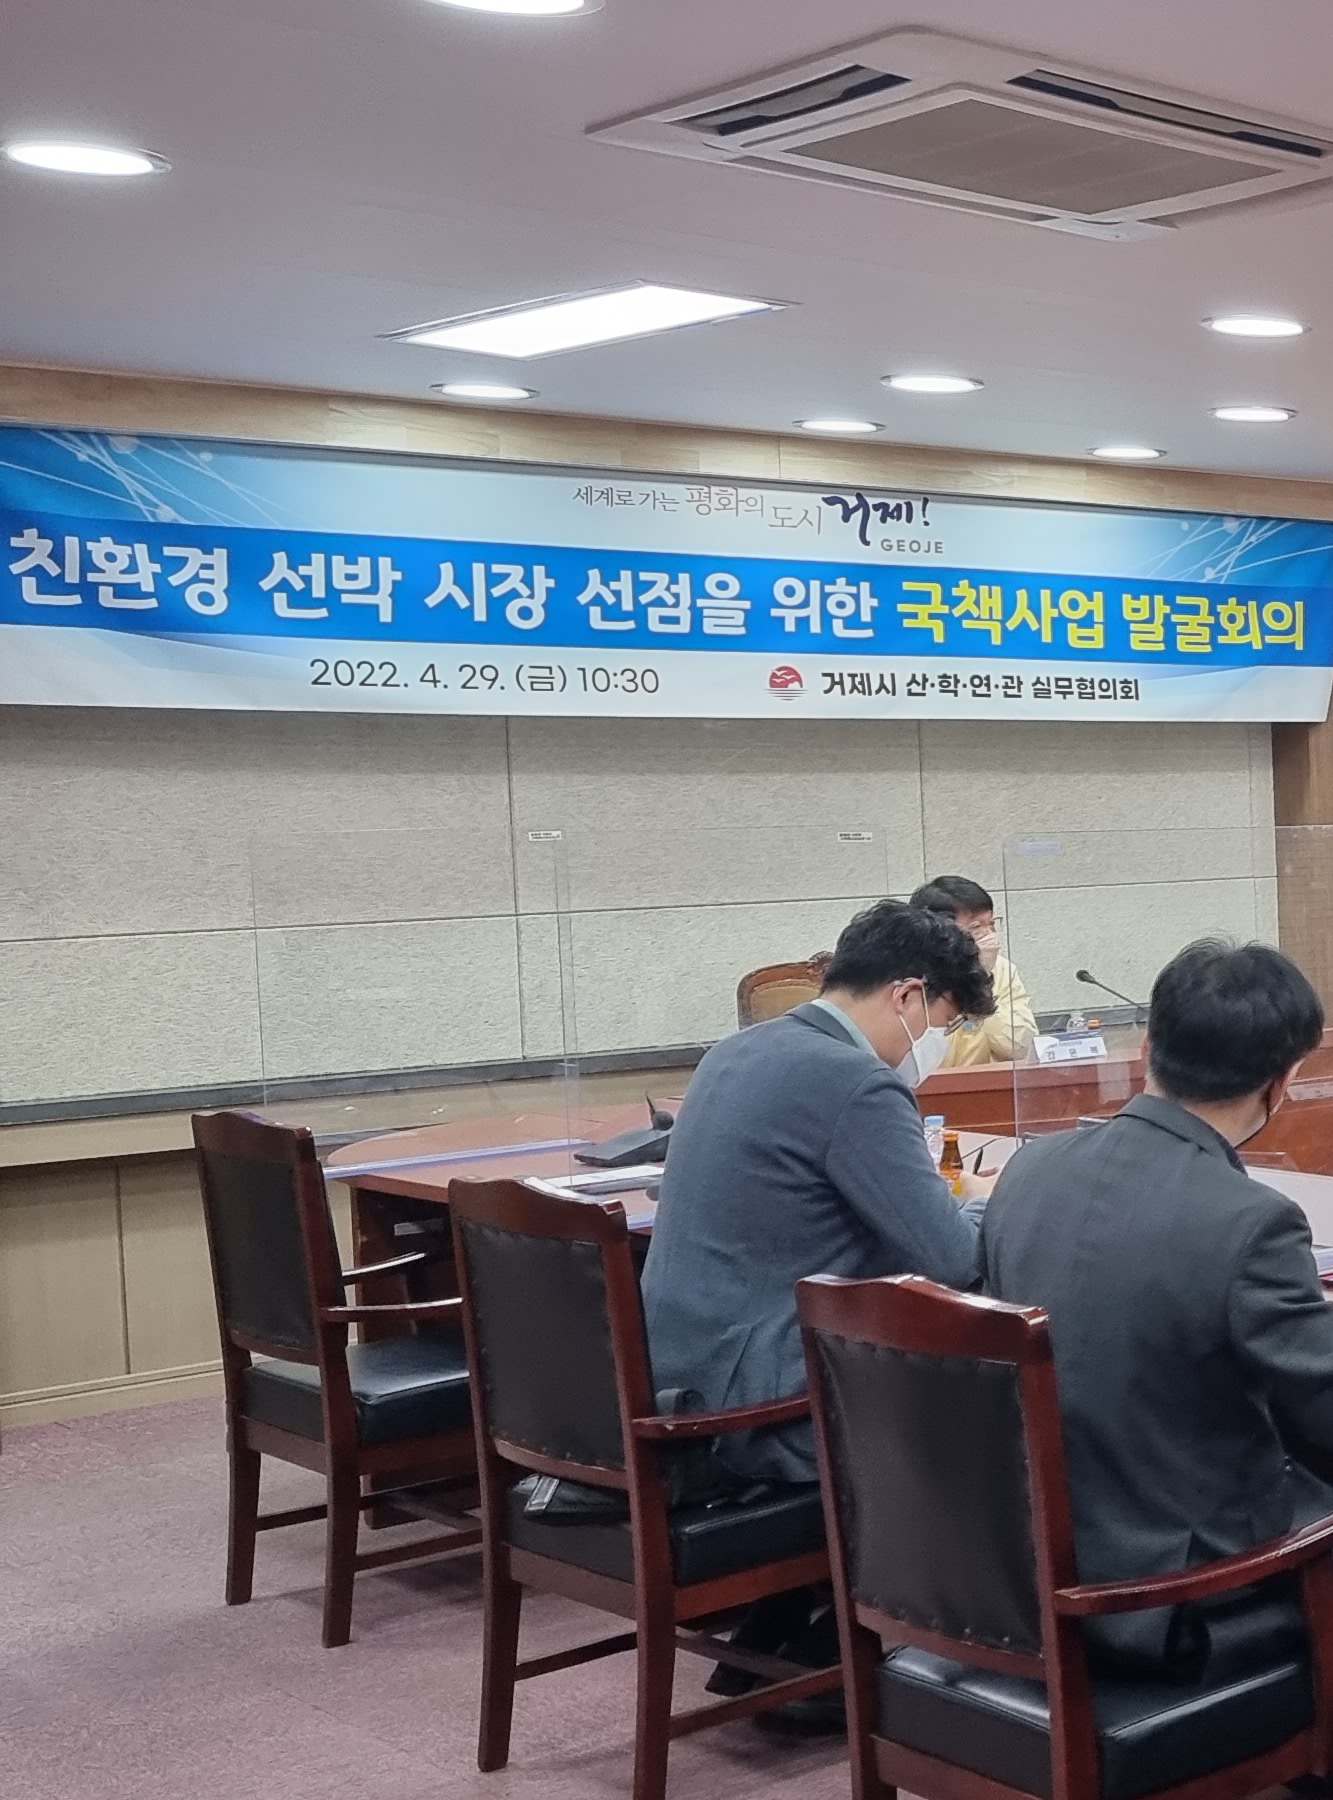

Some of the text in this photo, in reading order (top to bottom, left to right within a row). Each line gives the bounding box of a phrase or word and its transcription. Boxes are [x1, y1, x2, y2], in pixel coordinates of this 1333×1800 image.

[572, 485, 930, 546] 세계로 가는 평화의 도시 거제!
[881, 538, 944, 555] GEOJE
[8, 527, 1305, 653] 친환경 선박 시장 선점을 위한 국책사업 발굴회의
[309, 658, 660, 693] 2022. 4. 29. (금) 10:30
[821, 672, 897, 697] 거제시
[1031, 675, 1140, 701] 실무협의회
